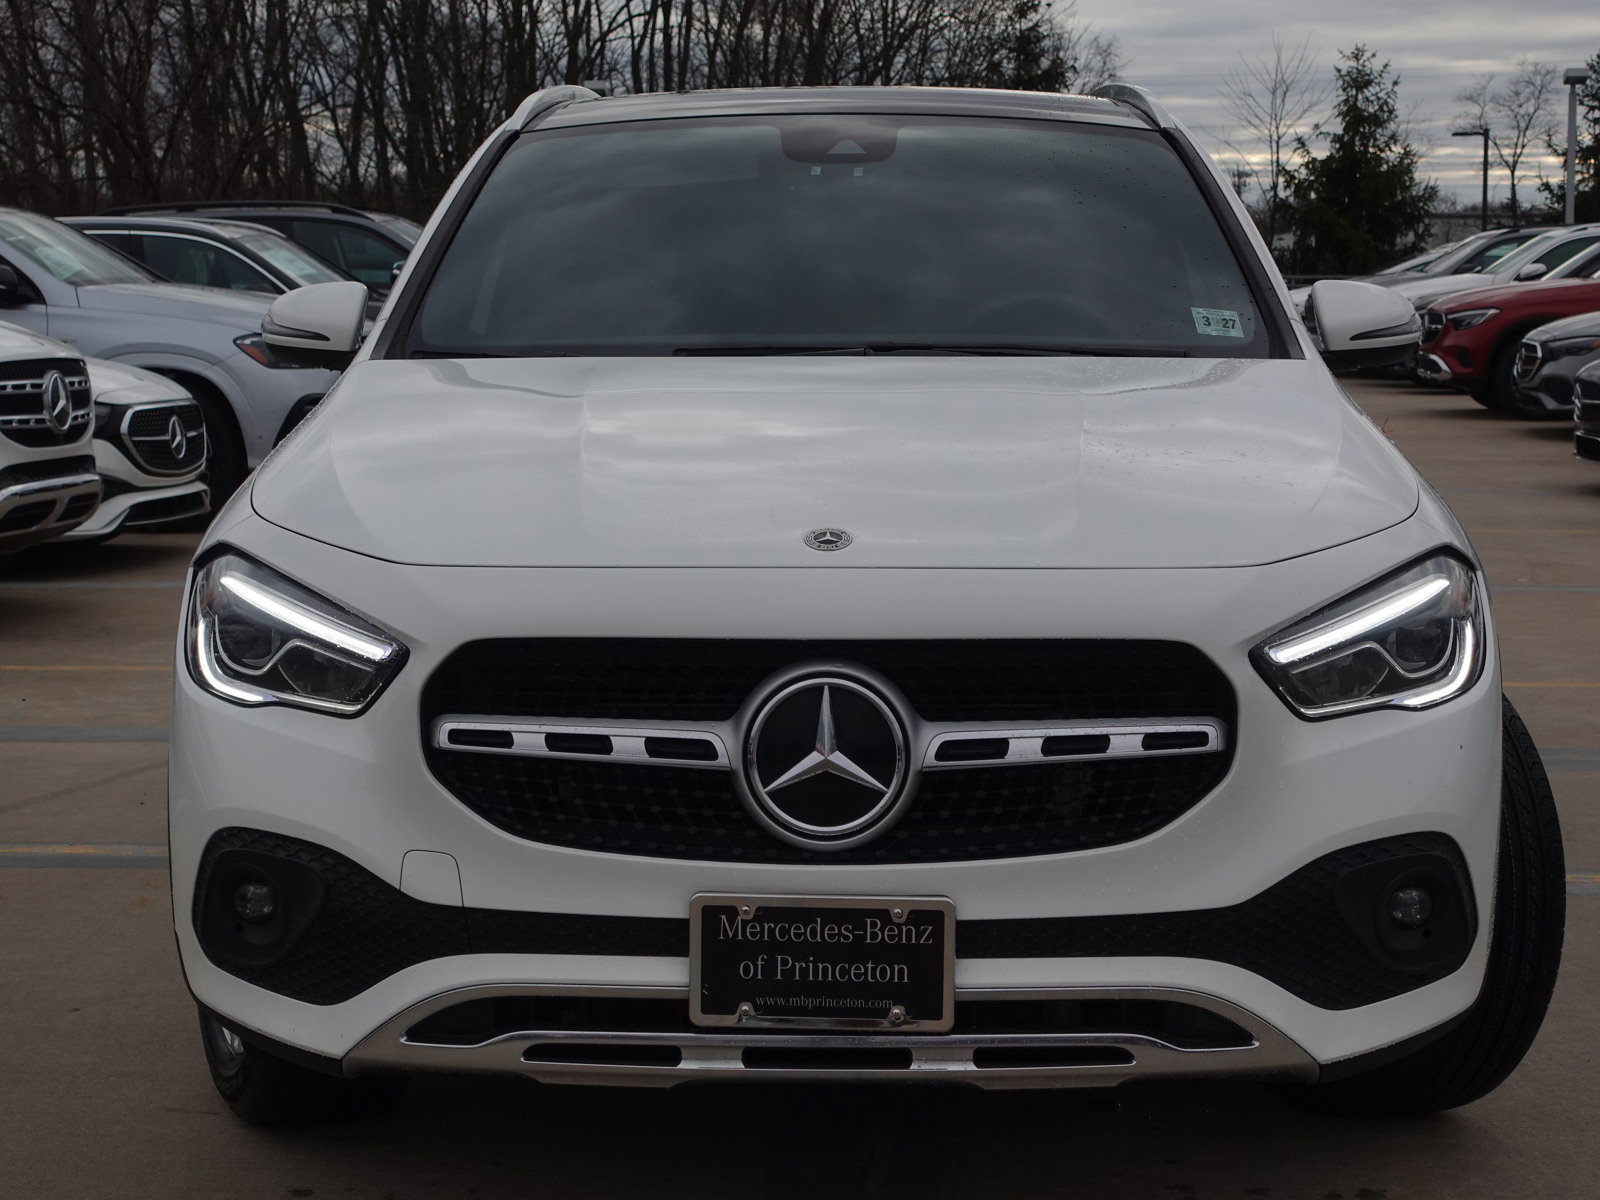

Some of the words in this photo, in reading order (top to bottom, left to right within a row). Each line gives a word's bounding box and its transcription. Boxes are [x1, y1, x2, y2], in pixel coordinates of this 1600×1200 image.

[1202, 315, 1211, 327] 3
[1221, 318, 1236, 329] 27
[718, 914, 933, 944] Mercedes-Benz
[739, 954, 768, 980] of
[775, 955, 910, 983] Princeton
[756, 994, 893, 1010] www.mbprinceton.com
